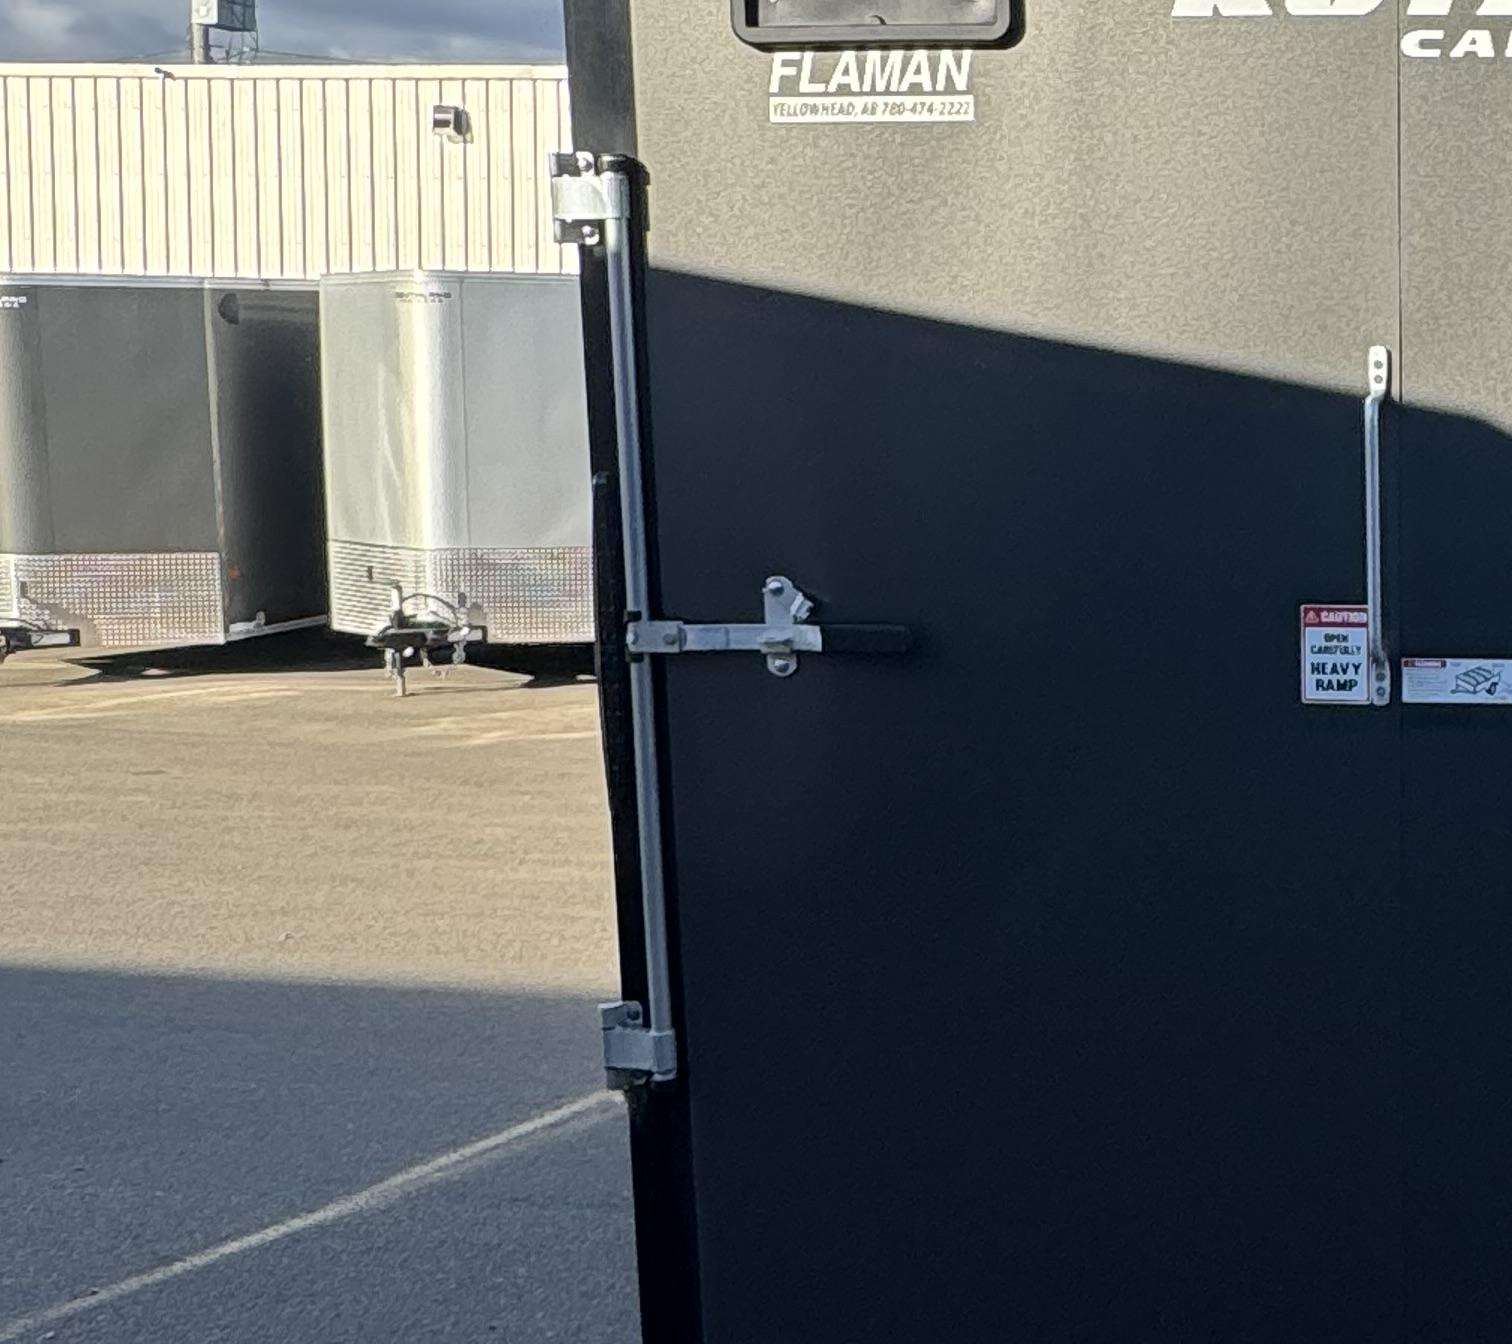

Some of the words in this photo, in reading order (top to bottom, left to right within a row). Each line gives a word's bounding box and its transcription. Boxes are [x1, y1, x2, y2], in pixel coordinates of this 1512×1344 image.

[769, 50, 973, 93] FLAMAN
[1324, 633, 1349, 643] OPEN
[1311, 662, 1362, 675] HEAVY
[1315, 679, 1358, 691] RAMP
